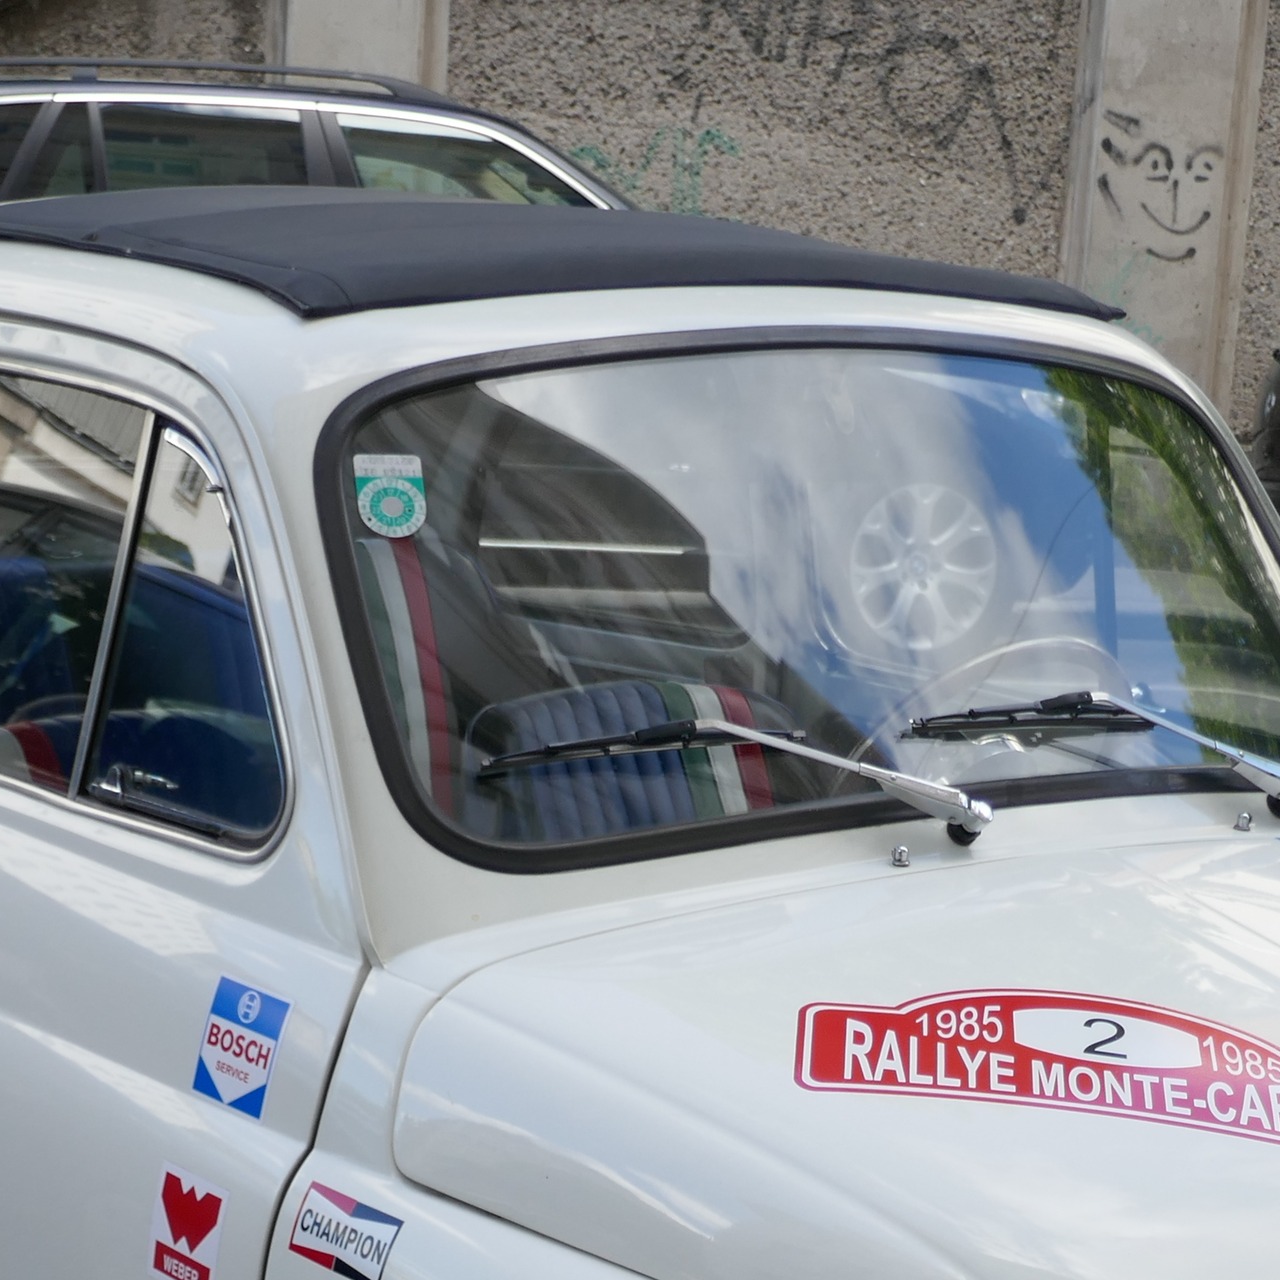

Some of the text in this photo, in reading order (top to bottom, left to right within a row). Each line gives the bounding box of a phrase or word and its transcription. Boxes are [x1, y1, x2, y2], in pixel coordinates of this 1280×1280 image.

[206, 1022, 272, 1070] BOSCH
[915, 1004, 1004, 1044] 1985
[1082, 1016, 1128, 1060] 2
[215, 1060, 250, 1084] SERVICE
[843, 1017, 1017, 1094] RALLYE
[300, 1208, 387, 1265] CHAMPION
